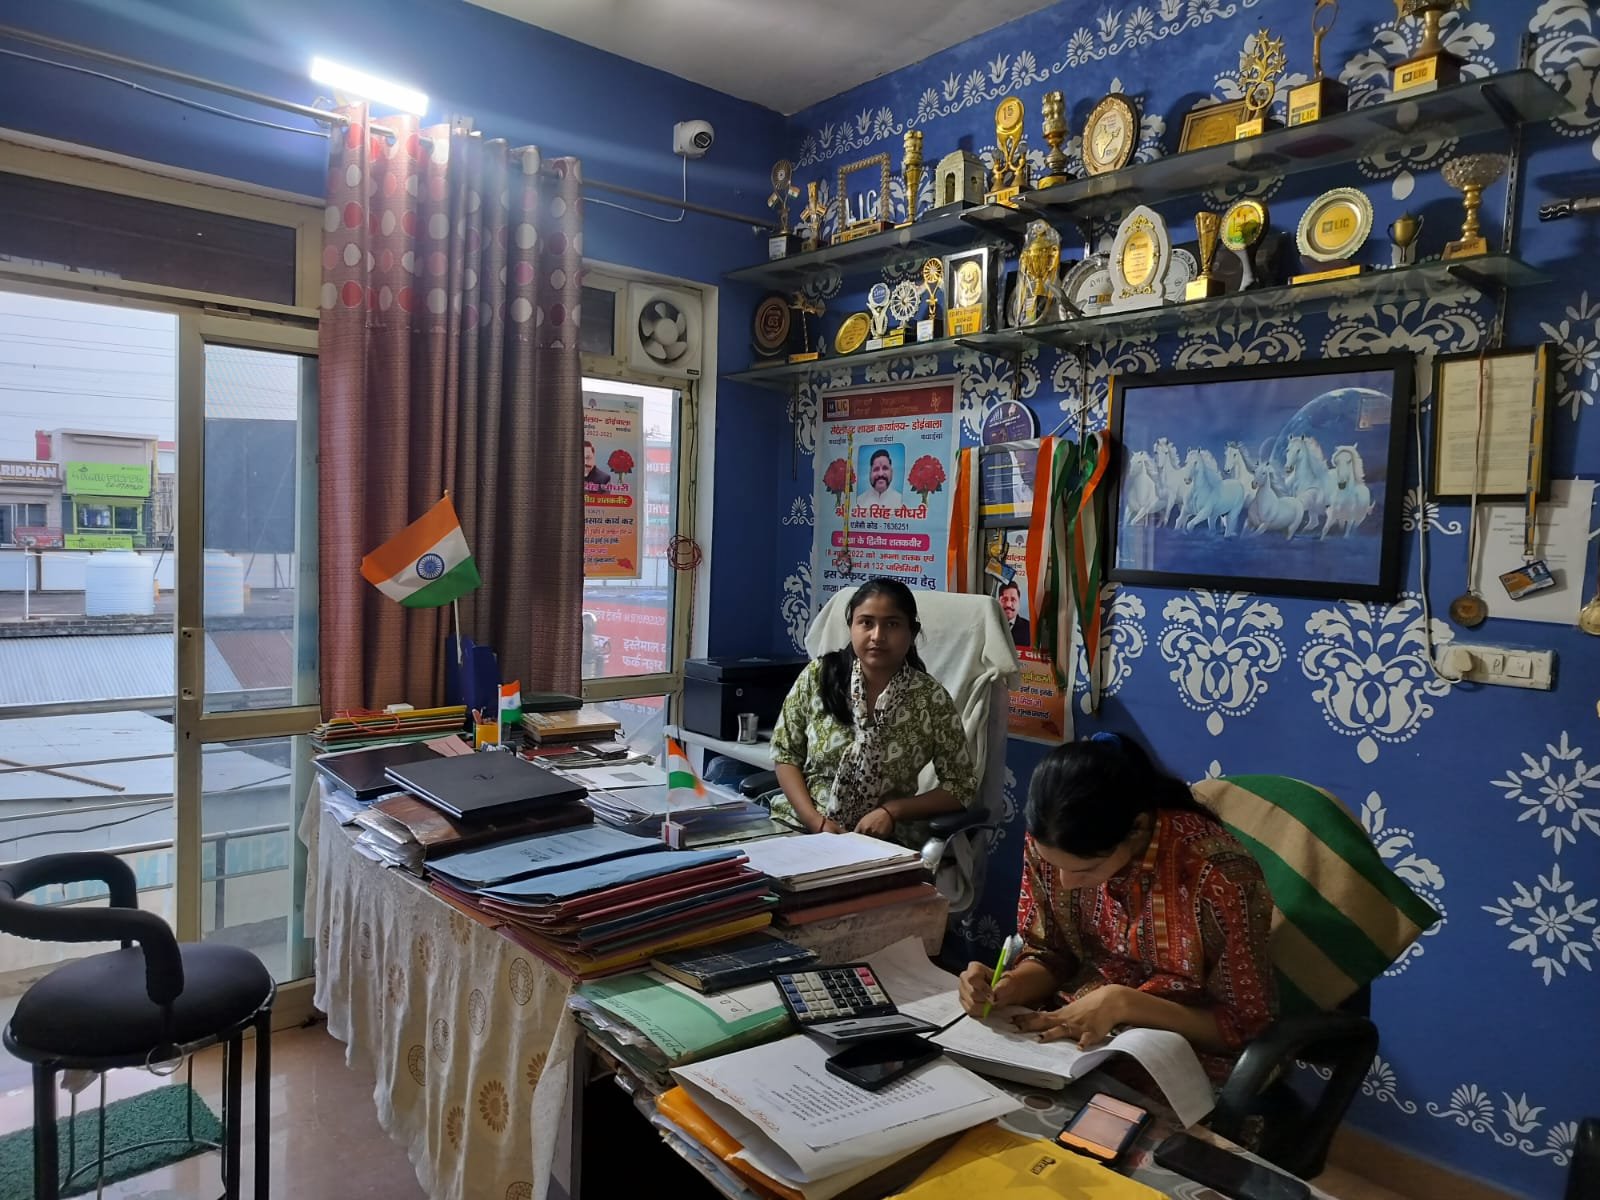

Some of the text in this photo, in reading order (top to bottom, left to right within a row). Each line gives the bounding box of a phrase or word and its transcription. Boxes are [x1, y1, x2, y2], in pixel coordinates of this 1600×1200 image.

[1414, 68, 1428, 79] LIC
[1302, 109, 1315, 121] LIC
[846, 190, 877, 224] LIC
[1334, 218, 1350, 230] LIC
[0, 464, 57, 478] RIDHAN
[851, 506, 866, 518] शेर
[870, 504, 892, 520] सिंह
[894, 504, 928, 520] चौधरी
[920, 574, 936, 590] हेतु
